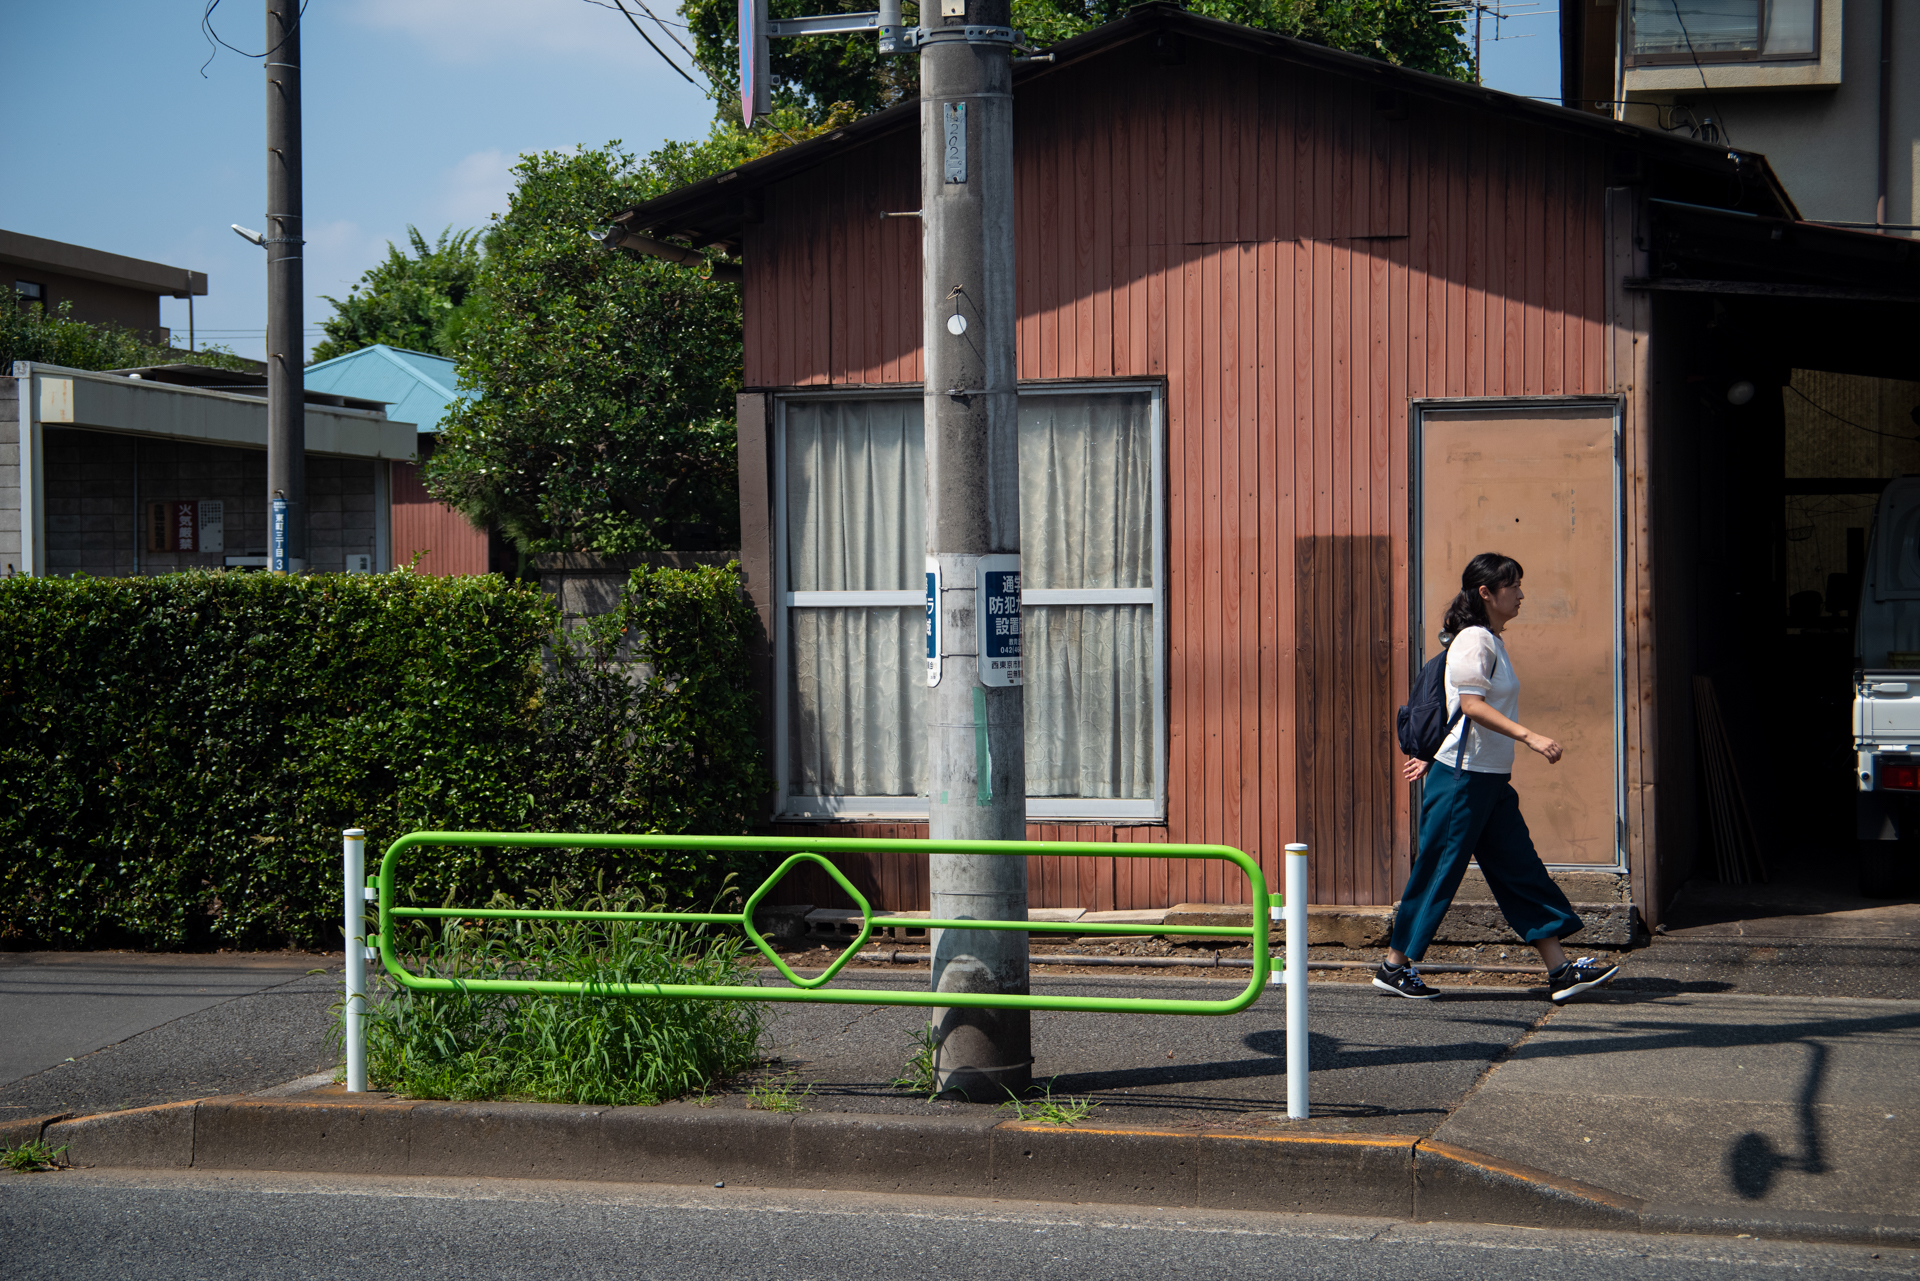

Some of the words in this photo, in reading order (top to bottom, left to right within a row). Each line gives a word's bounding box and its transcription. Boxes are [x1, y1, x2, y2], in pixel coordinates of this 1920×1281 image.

[179, 504, 192, 550] 火気厳禁
[275, 514, 284, 557] 東町三丁目
[276, 559, 283, 570] 3
